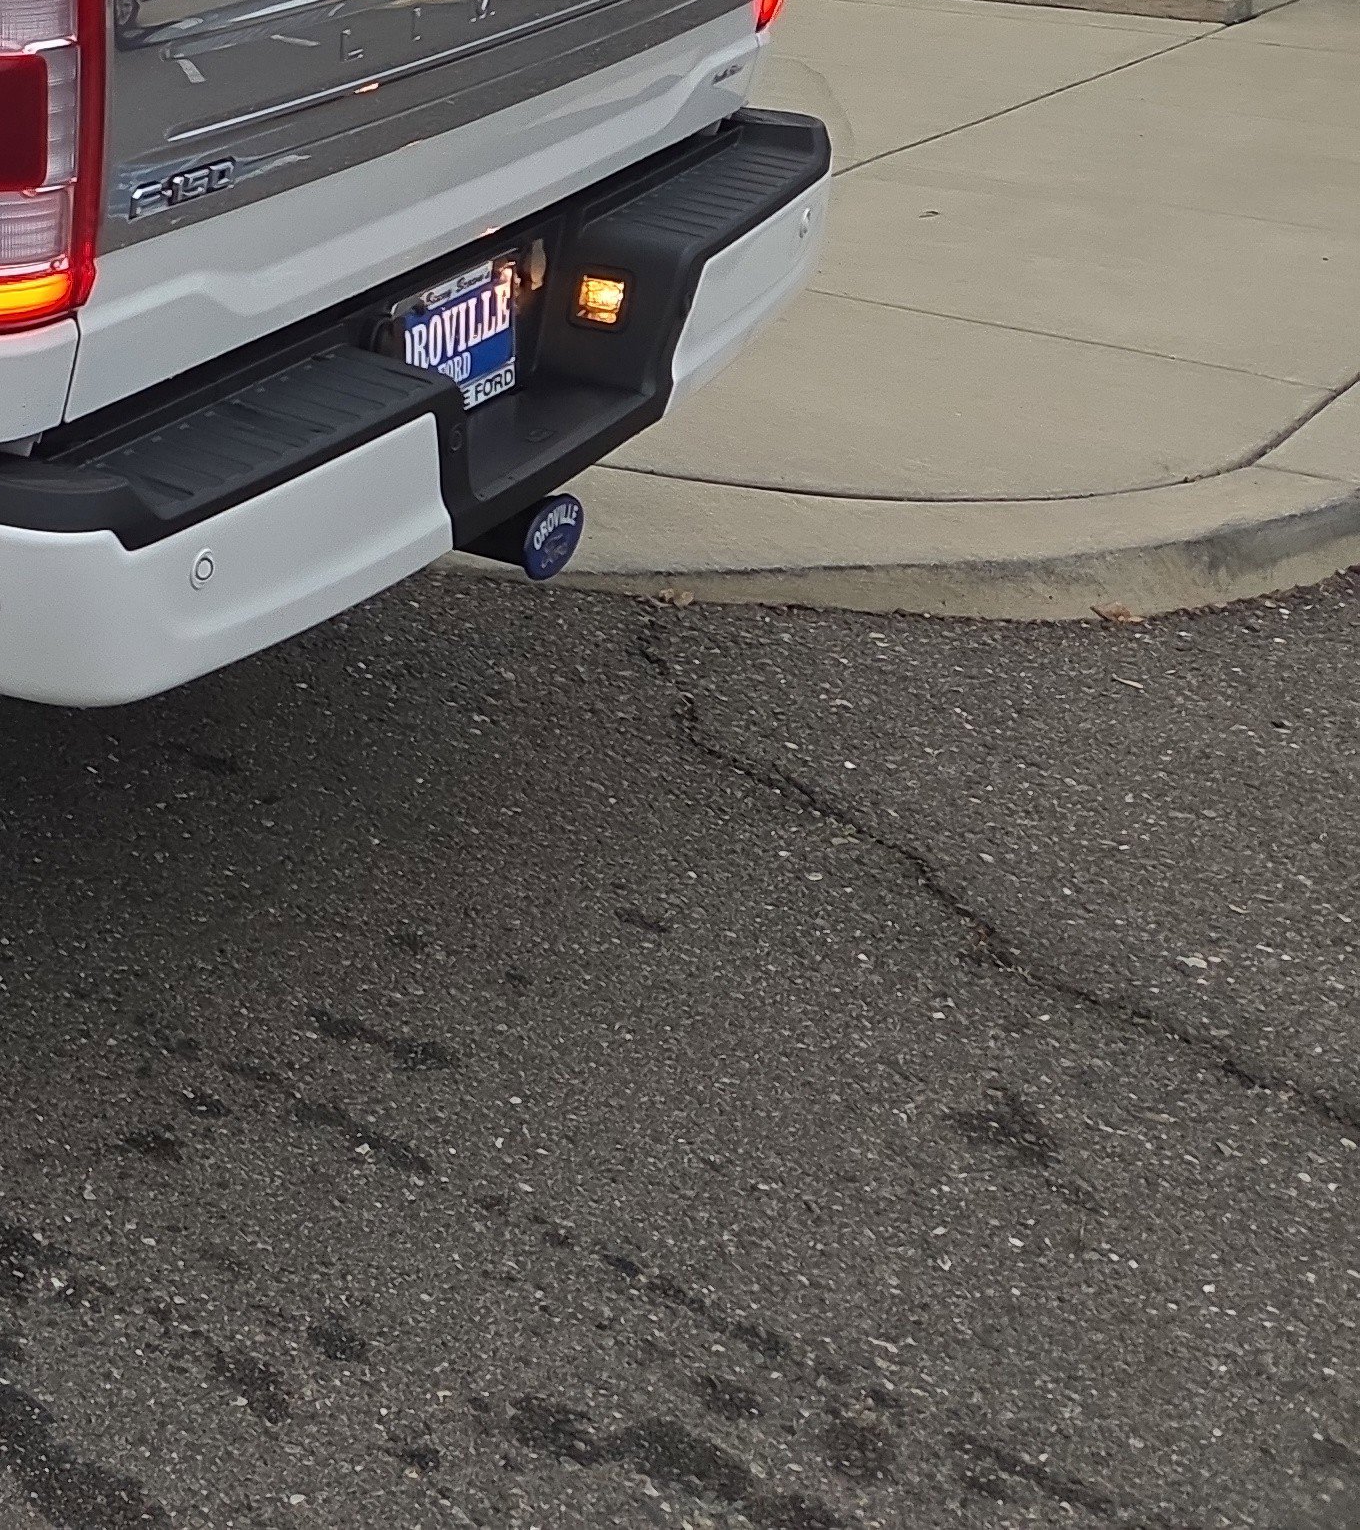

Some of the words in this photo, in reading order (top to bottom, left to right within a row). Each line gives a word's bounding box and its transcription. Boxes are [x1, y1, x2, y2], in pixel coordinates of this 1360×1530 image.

[129, 156, 236, 221] F-150
[474, 369, 513, 401] FORD
[533, 503, 579, 550] OROVILLE
